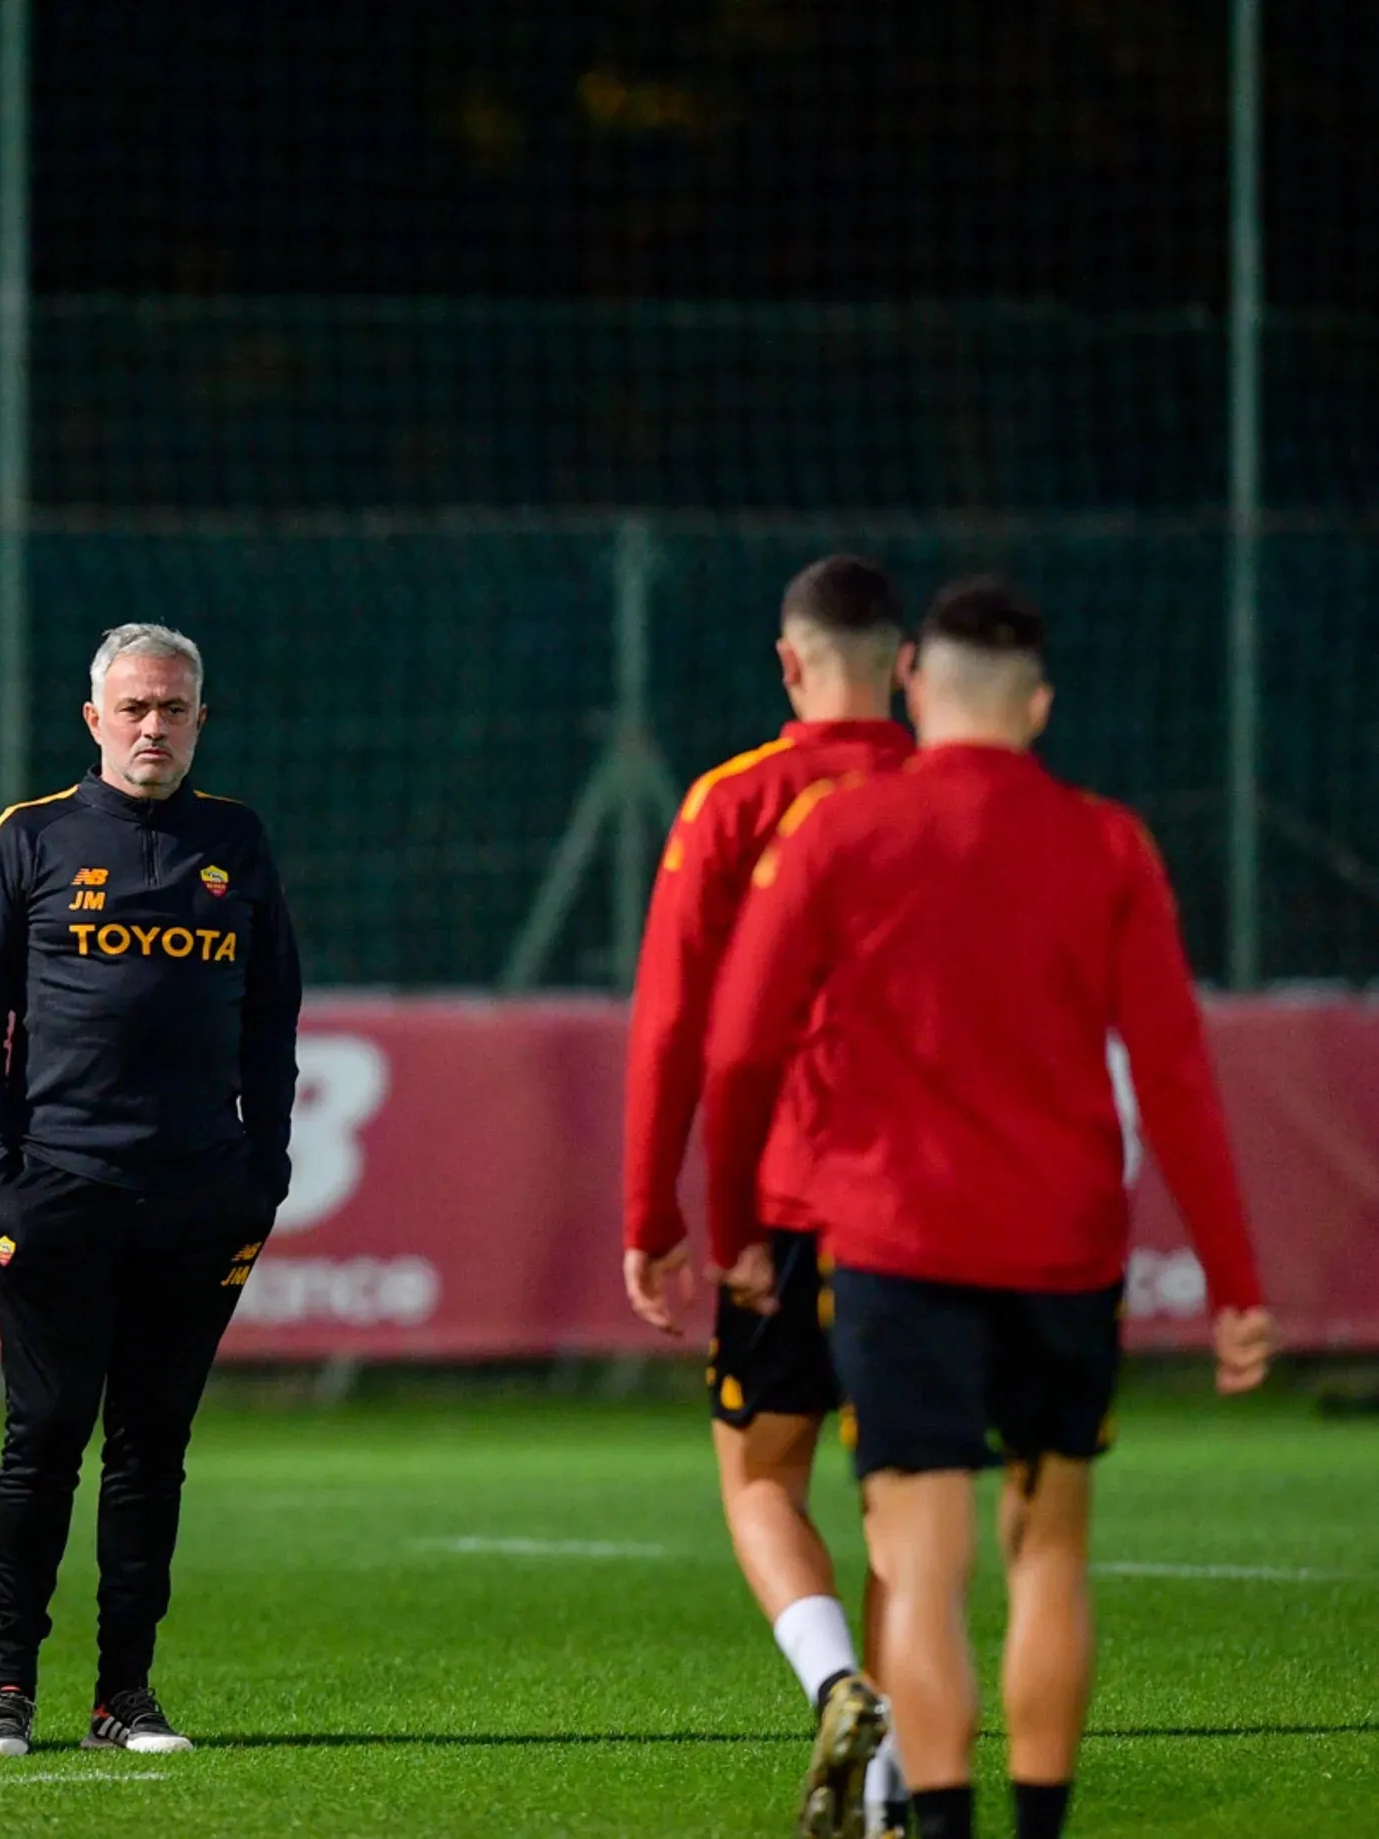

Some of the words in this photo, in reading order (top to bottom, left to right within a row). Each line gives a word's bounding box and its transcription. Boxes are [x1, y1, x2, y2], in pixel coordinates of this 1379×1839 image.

[71, 868, 109, 886] NB
[69, 890, 106, 911] JM
[69, 924, 237, 962] TOYOTA
[274, 1034, 390, 1238] B
[220, 1265, 250, 1287] JM
